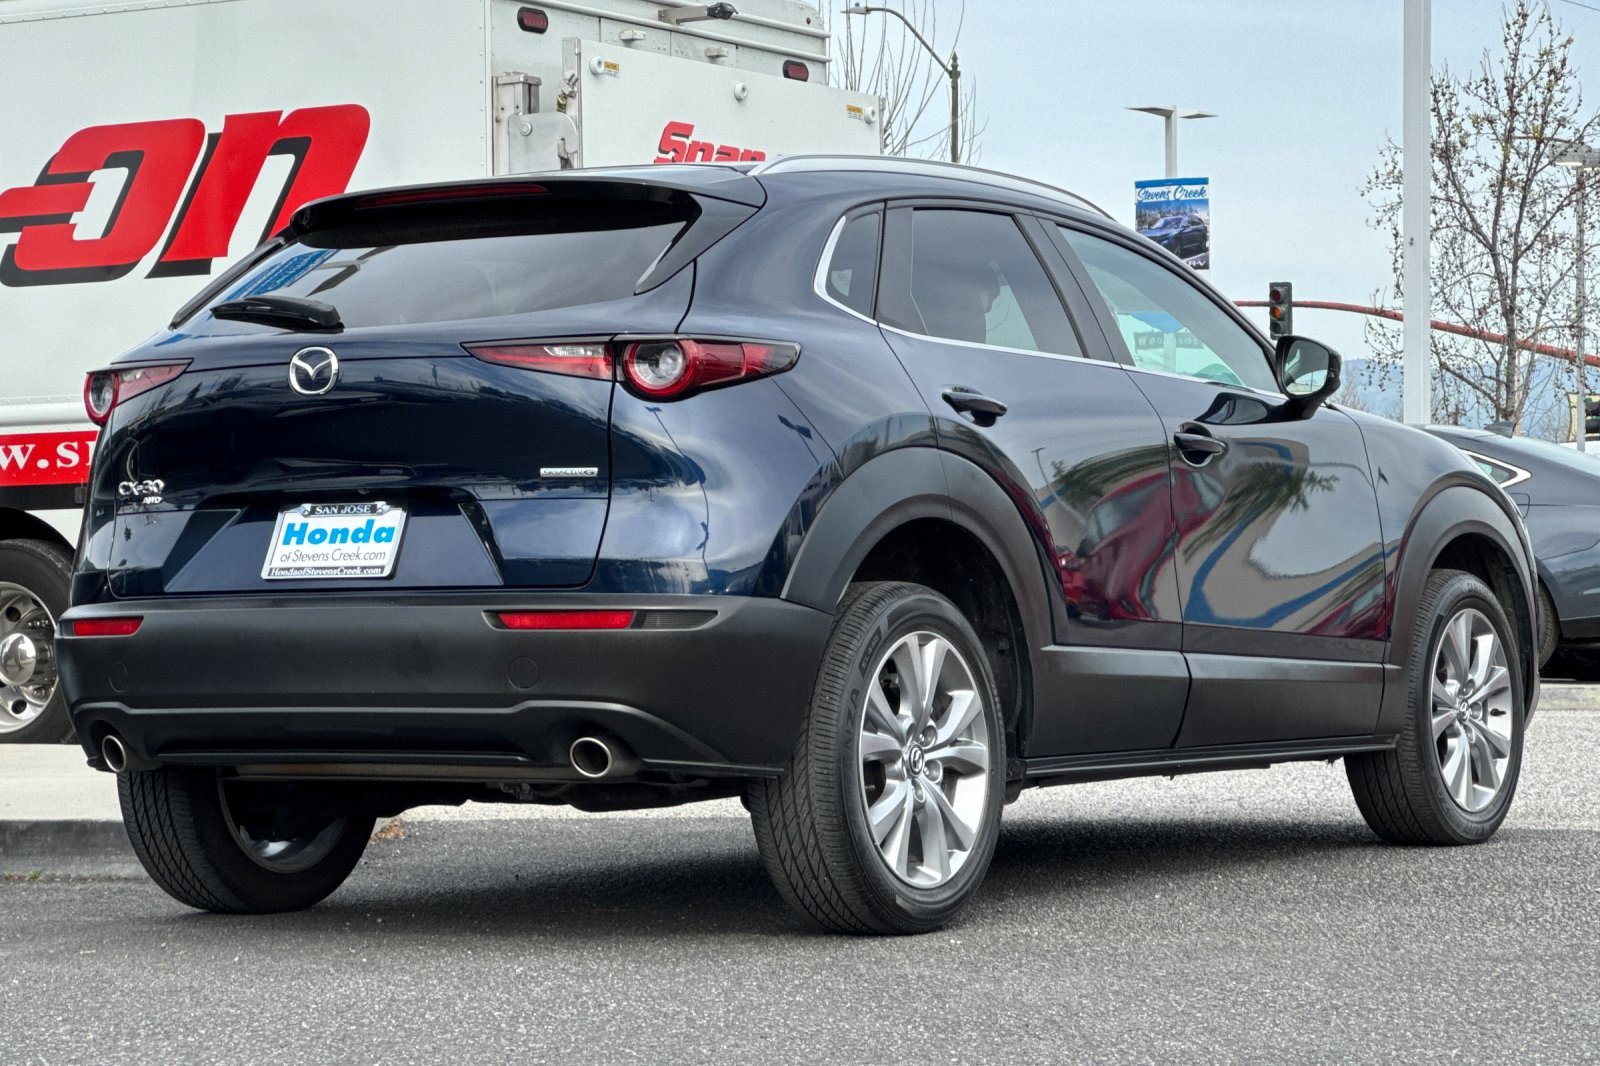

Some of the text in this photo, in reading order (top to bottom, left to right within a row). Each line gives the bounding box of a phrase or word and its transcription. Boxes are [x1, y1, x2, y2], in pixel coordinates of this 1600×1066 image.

[1138, 185, 1206, 202] Stevens Creek
[118, 479, 165, 496] CX-30
[315, 504, 371, 515] SAN JOSE
[282, 519, 395, 545] Honda
[280, 546, 386, 563] of Stevens Creek.com
[270, 567, 382, 577] HondaofStevensCreek.com
